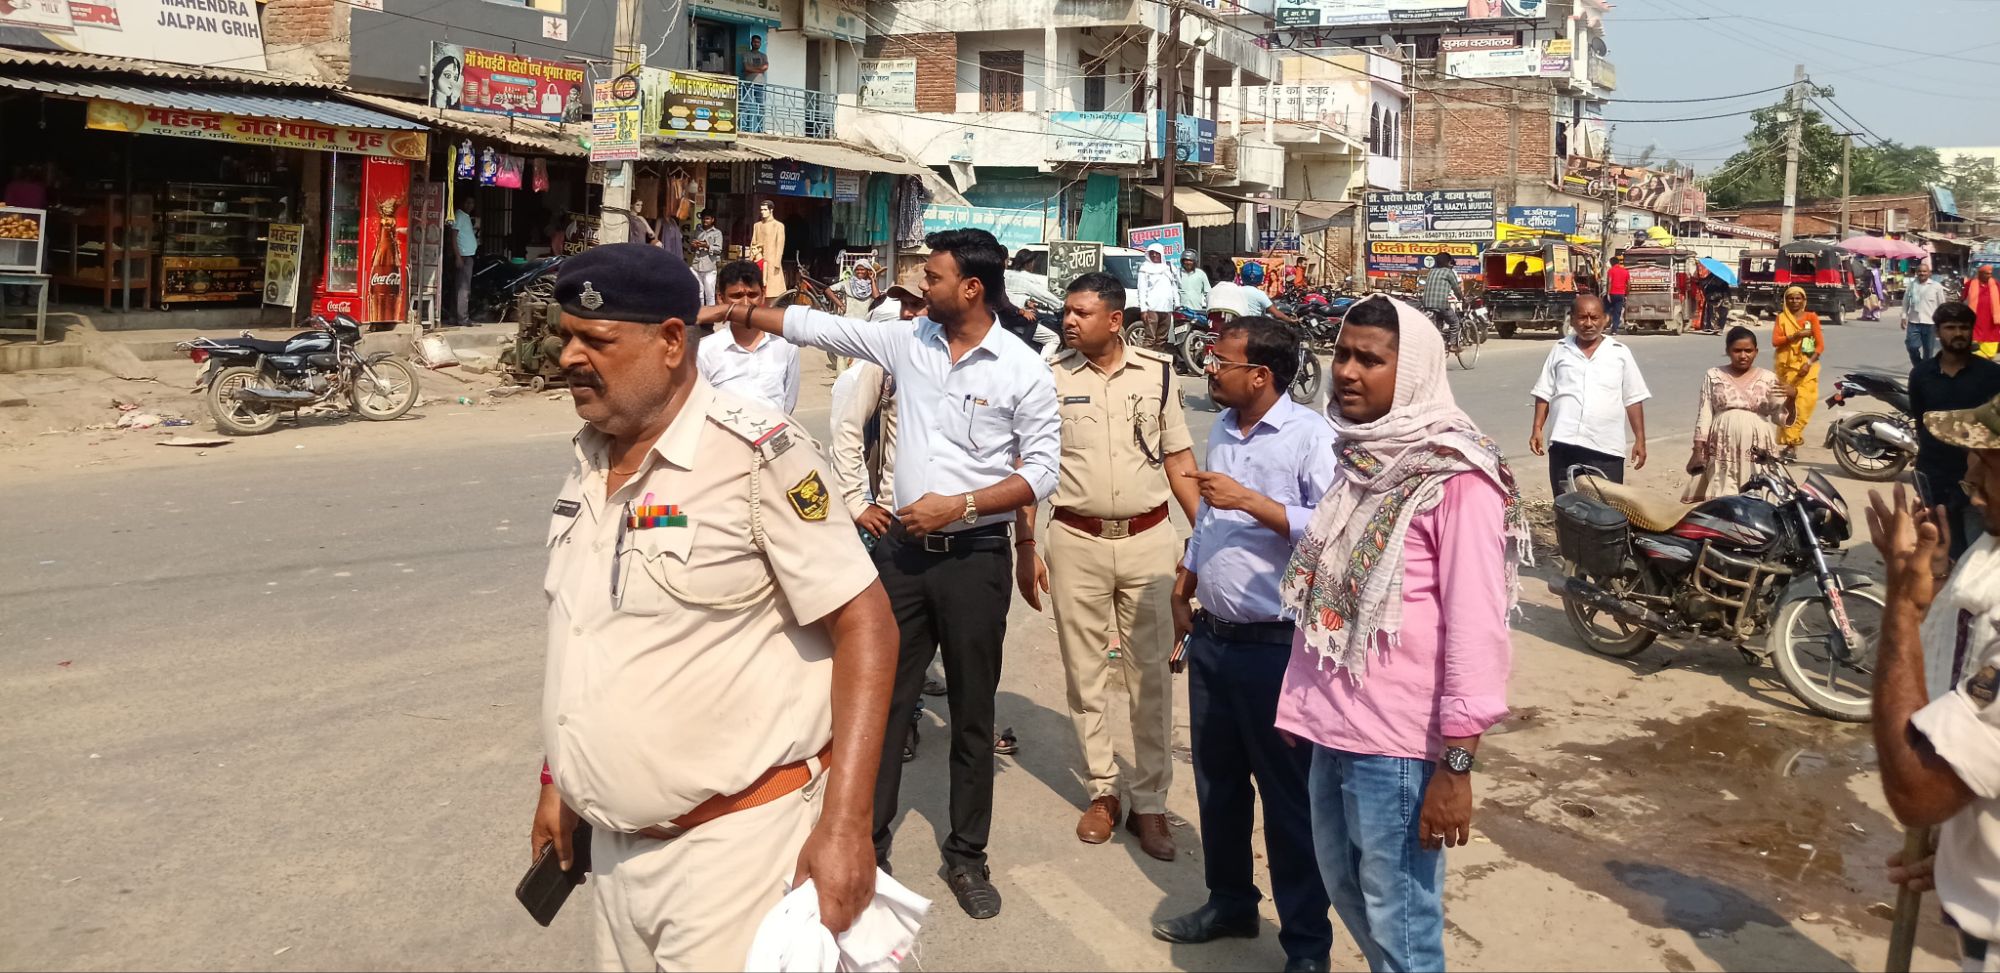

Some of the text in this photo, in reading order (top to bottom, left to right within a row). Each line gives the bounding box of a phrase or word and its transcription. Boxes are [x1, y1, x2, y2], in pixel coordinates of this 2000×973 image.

[157, 11, 259, 39] JALPAN GRIH
[1442, 38, 1514, 50] सुमन वस्त्रालय
[529, 60, 542, 77] एवं
[565, 68, 585, 83] सदन
[692, 80, 708, 97] SONS
[709, 82, 737, 99] GARMENTS
[235, 116, 338, 144] जलपान
[347, 129, 385, 151] गृह
[779, 169, 801, 181] asian
[1444, 202, 1467, 211] NAAZYA
[1468, 201, 1493, 210] MUMTAZ
[1528, 215, 1557, 227] दीपिका
[1163, 228, 1180, 239] DR
[1069, 246, 1096, 269] रॉयल
